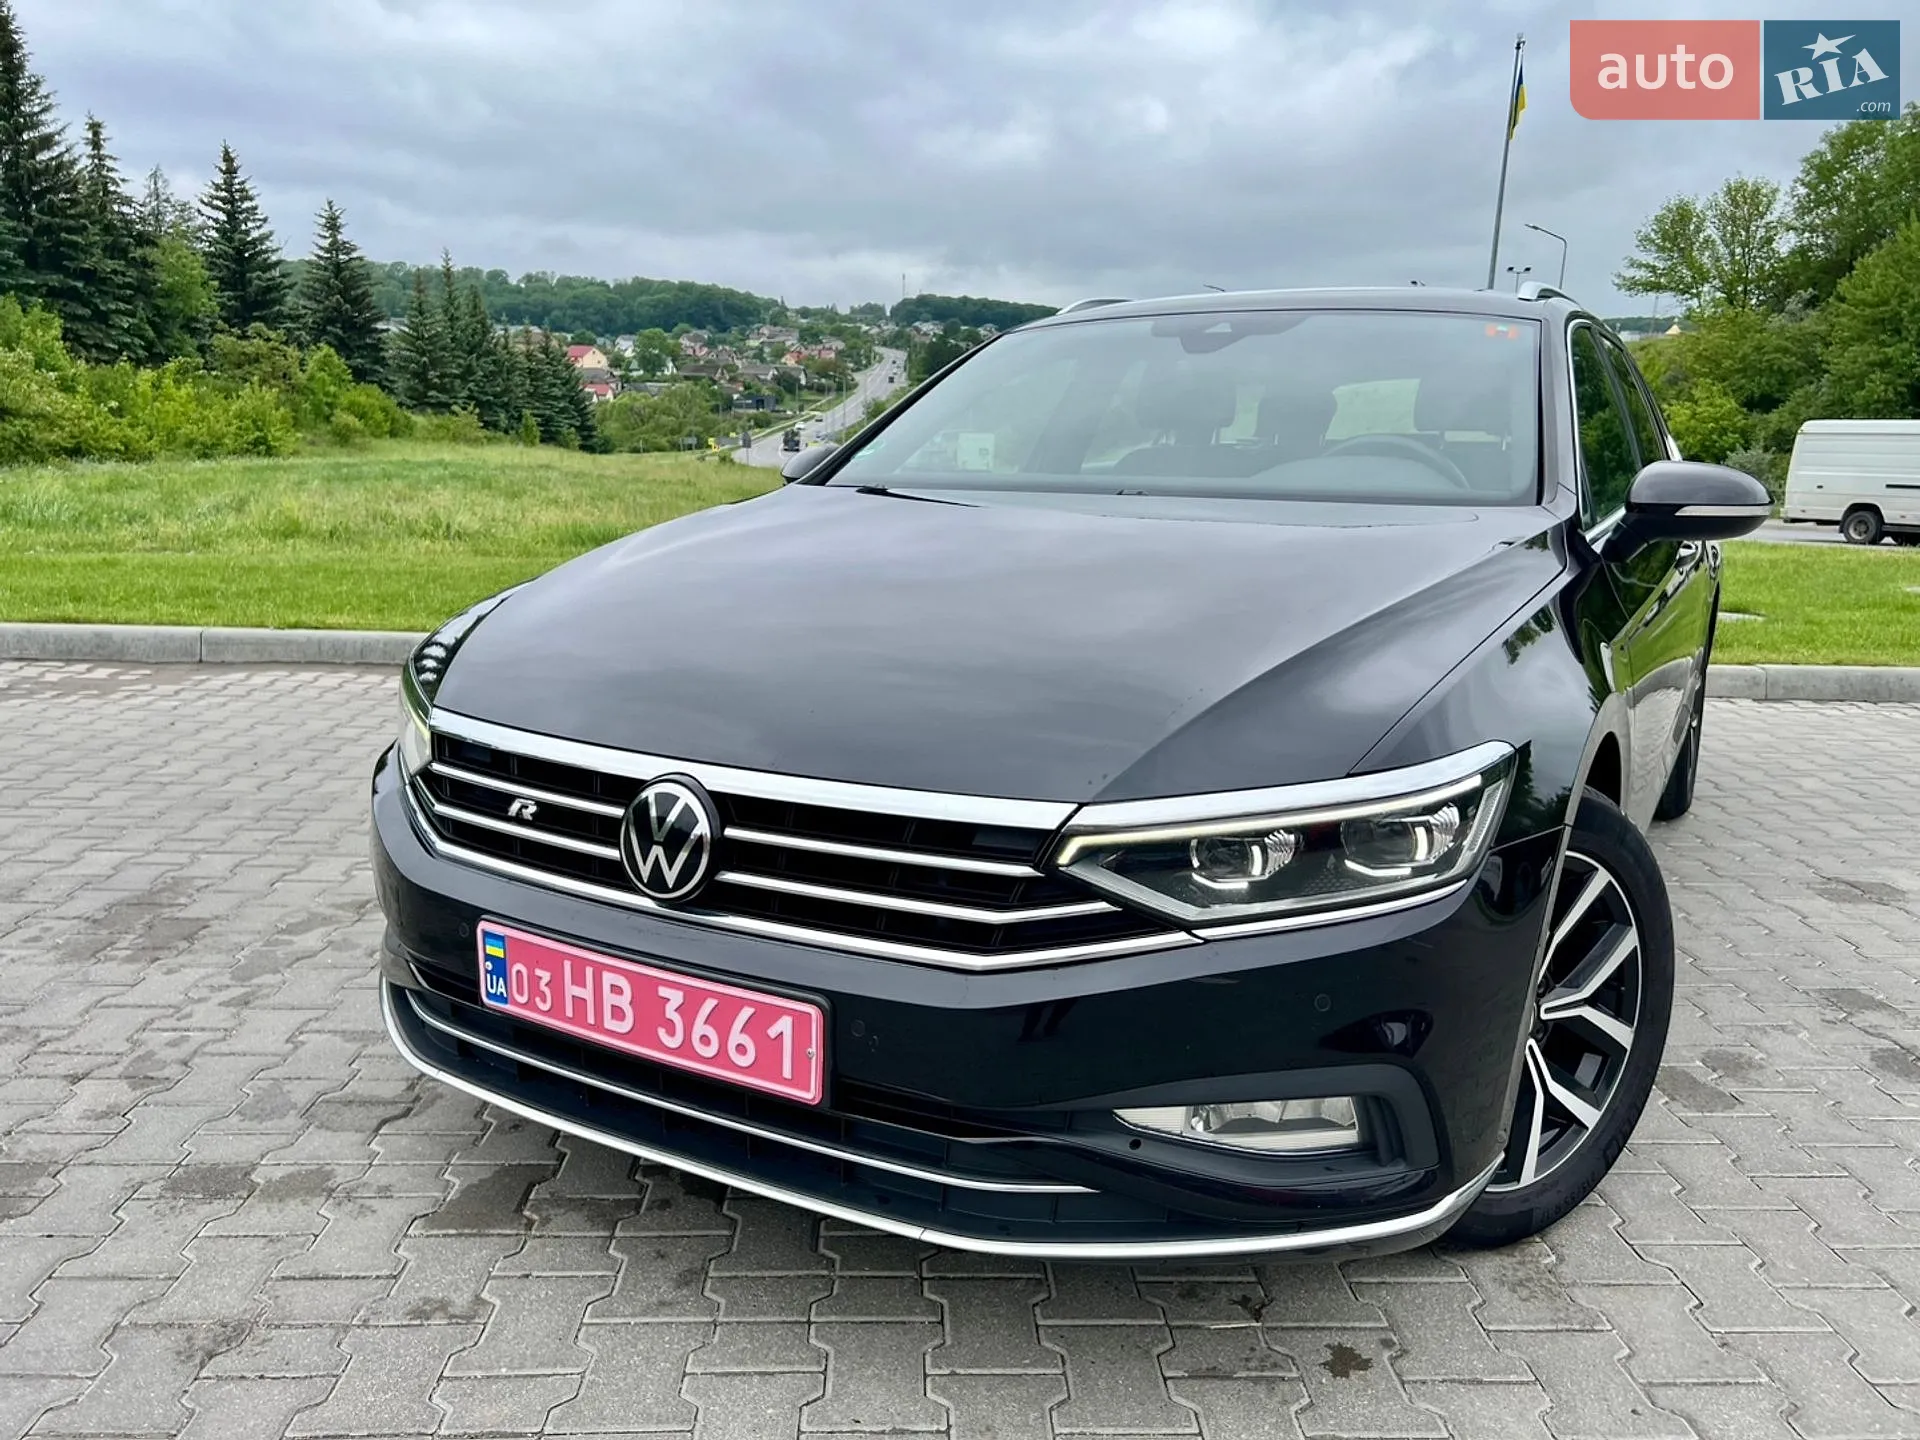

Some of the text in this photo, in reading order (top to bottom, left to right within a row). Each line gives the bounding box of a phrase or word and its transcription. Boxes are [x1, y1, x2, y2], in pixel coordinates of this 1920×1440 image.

[508, 799, 539, 821] R
[486, 973, 507, 998] UA
[511, 960, 795, 1080] 03 HB 3661
